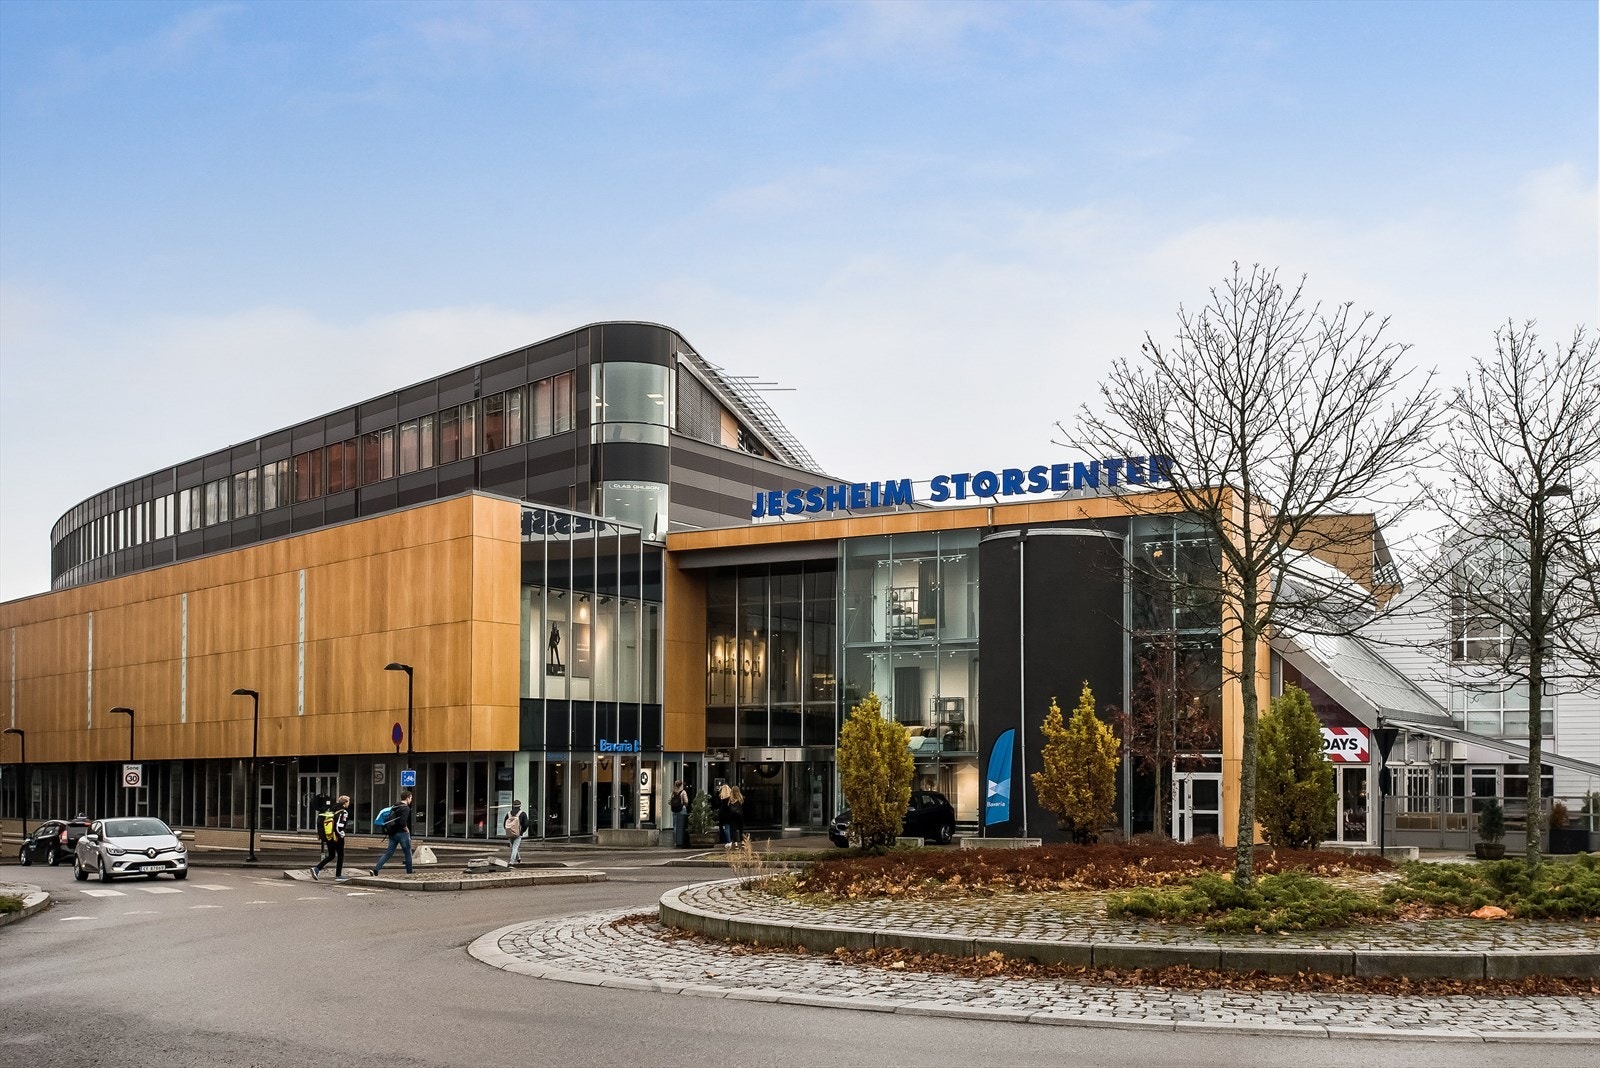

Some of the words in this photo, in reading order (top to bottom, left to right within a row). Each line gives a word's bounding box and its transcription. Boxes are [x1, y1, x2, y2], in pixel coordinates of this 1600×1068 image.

[751, 478, 914, 518] JESSHEIM
[930, 454, 1175, 502] STORSENTER
[600, 739, 632, 752] Bavaria
